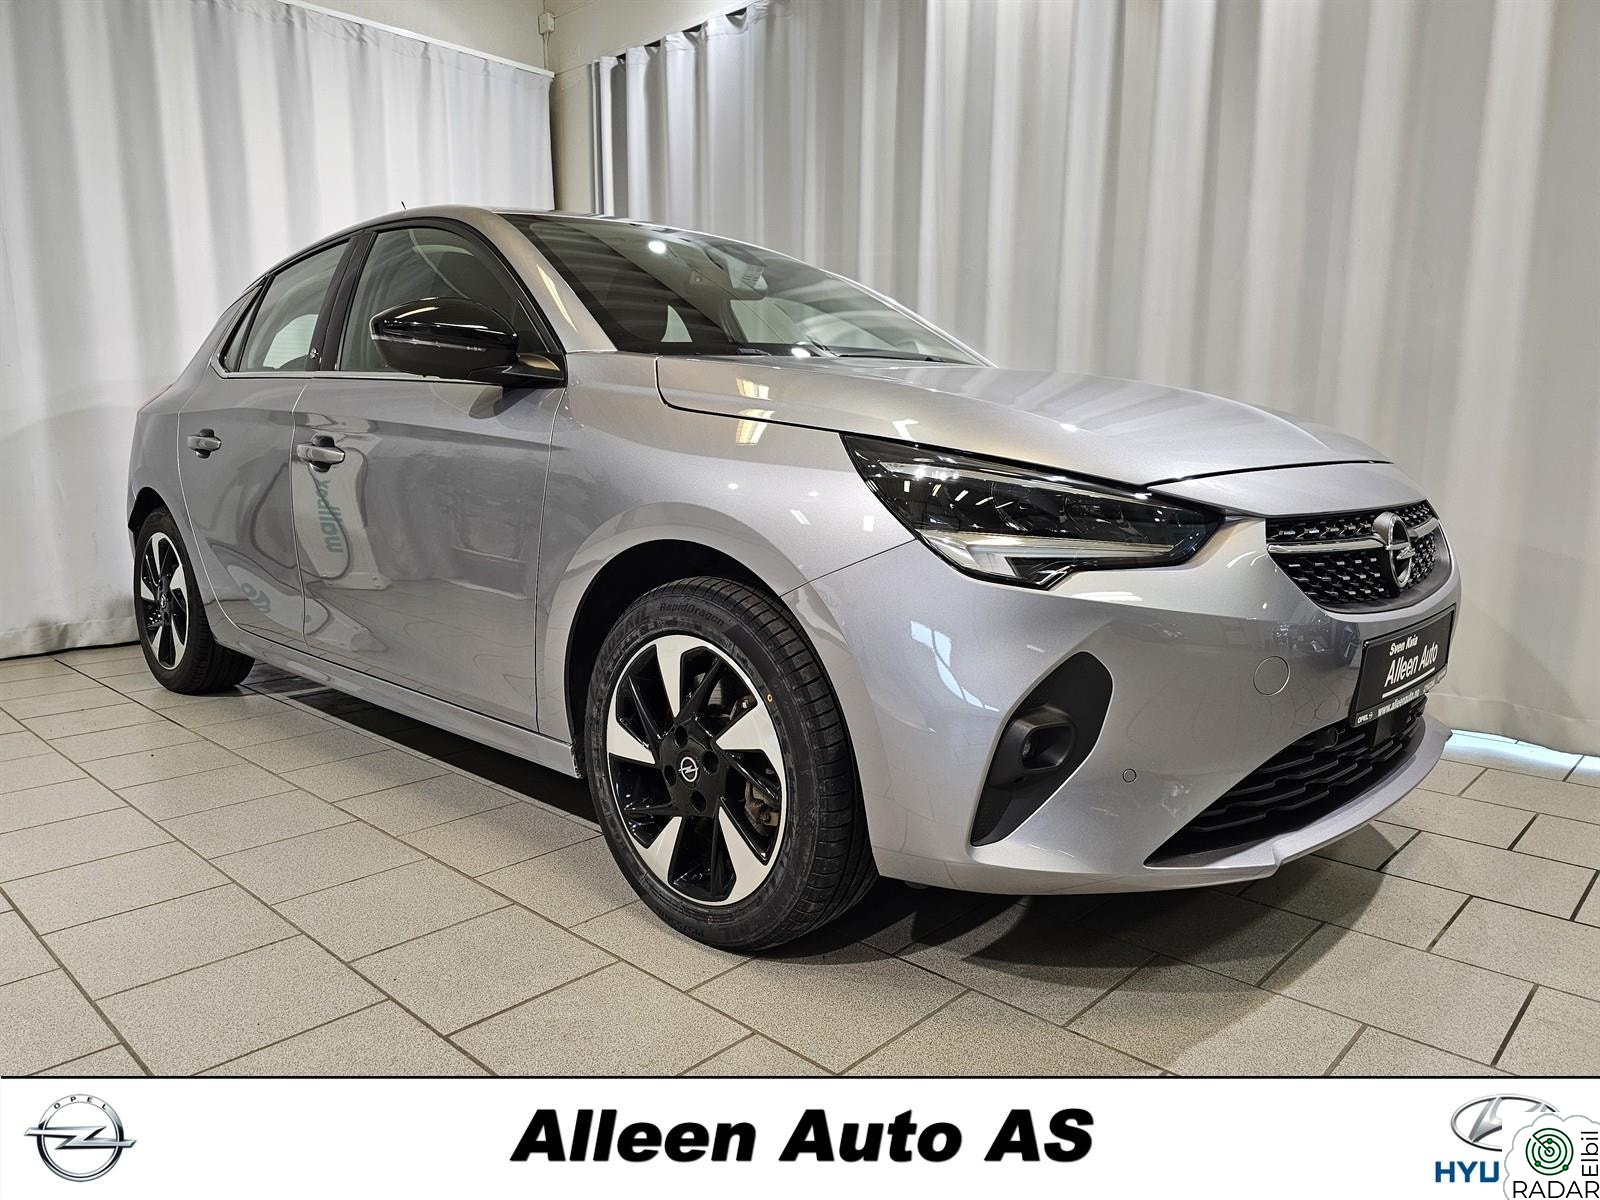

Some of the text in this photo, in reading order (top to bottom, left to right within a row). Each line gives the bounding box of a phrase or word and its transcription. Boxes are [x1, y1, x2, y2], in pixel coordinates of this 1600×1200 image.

[660, 602, 725, 626] RapidDragon
[1389, 642, 1405, 656] Sven
[1384, 656, 1418, 687] Alleen
[1419, 643, 1438, 671] Auto
